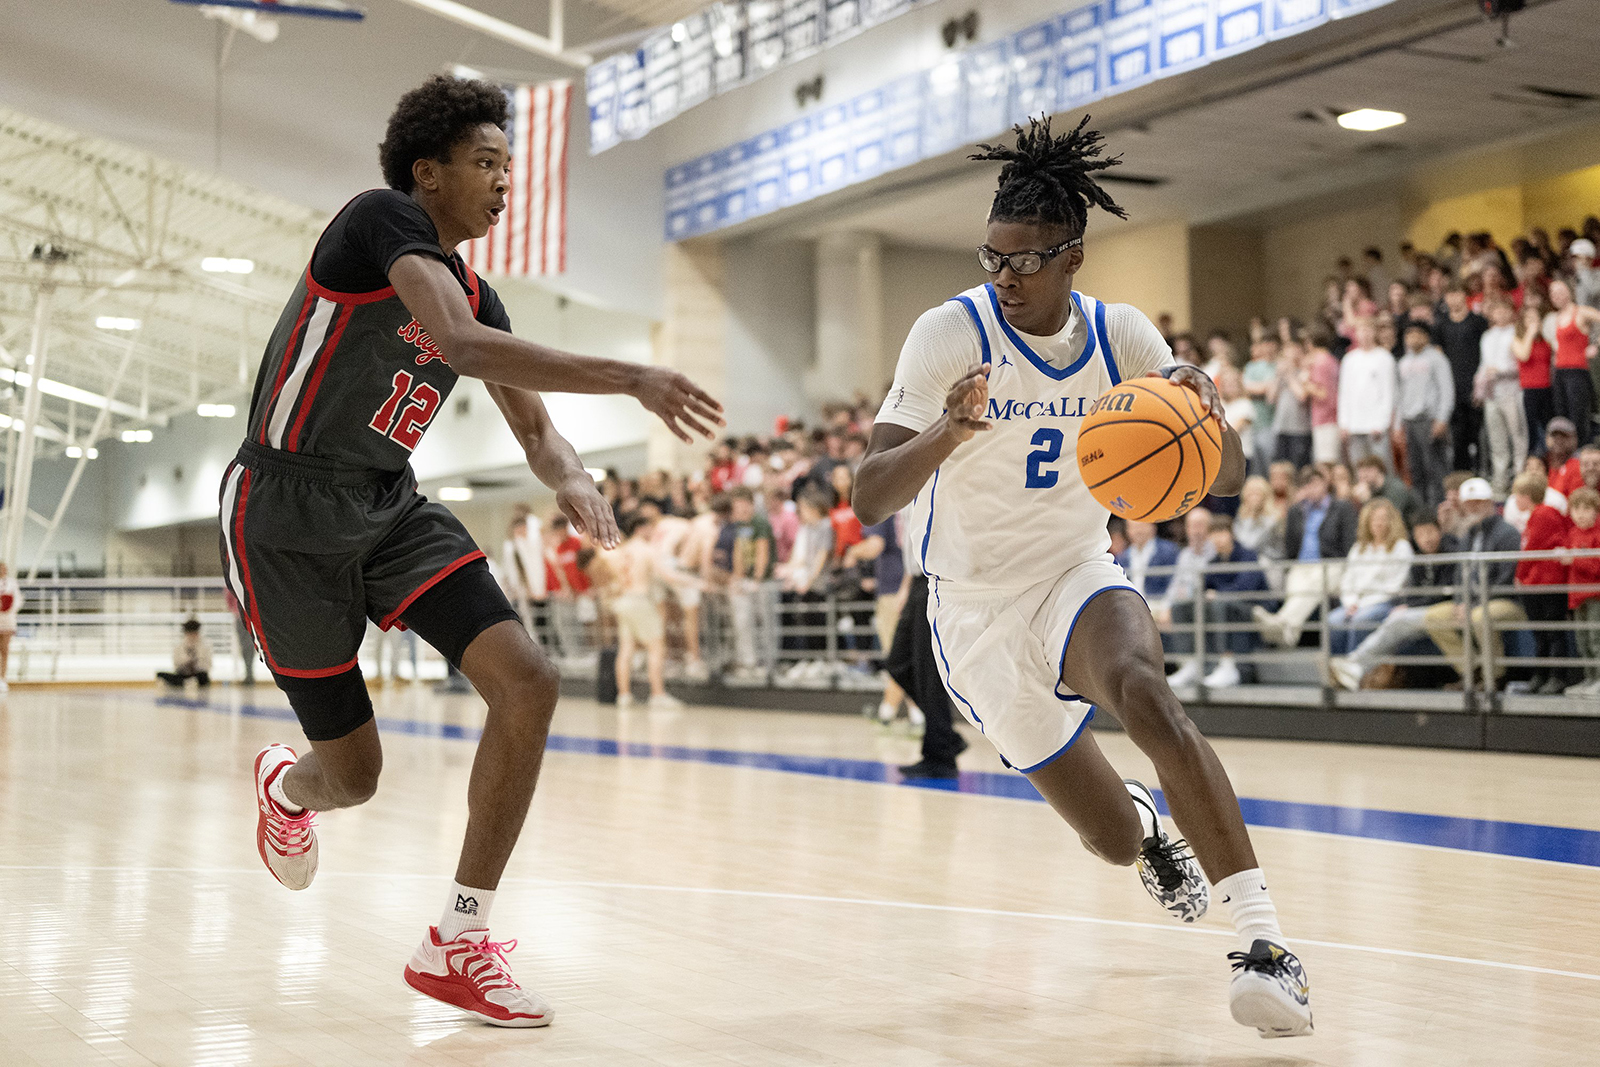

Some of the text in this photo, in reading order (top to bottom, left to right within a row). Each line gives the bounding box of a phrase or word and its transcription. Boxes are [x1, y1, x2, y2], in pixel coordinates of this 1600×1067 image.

[397, 316, 452, 366] Bay
[368, 369, 441, 453] 12
[984, 396, 1096, 421] McCALL
[1089, 392, 1137, 416] Wil
[1025, 427, 1064, 489] 2
